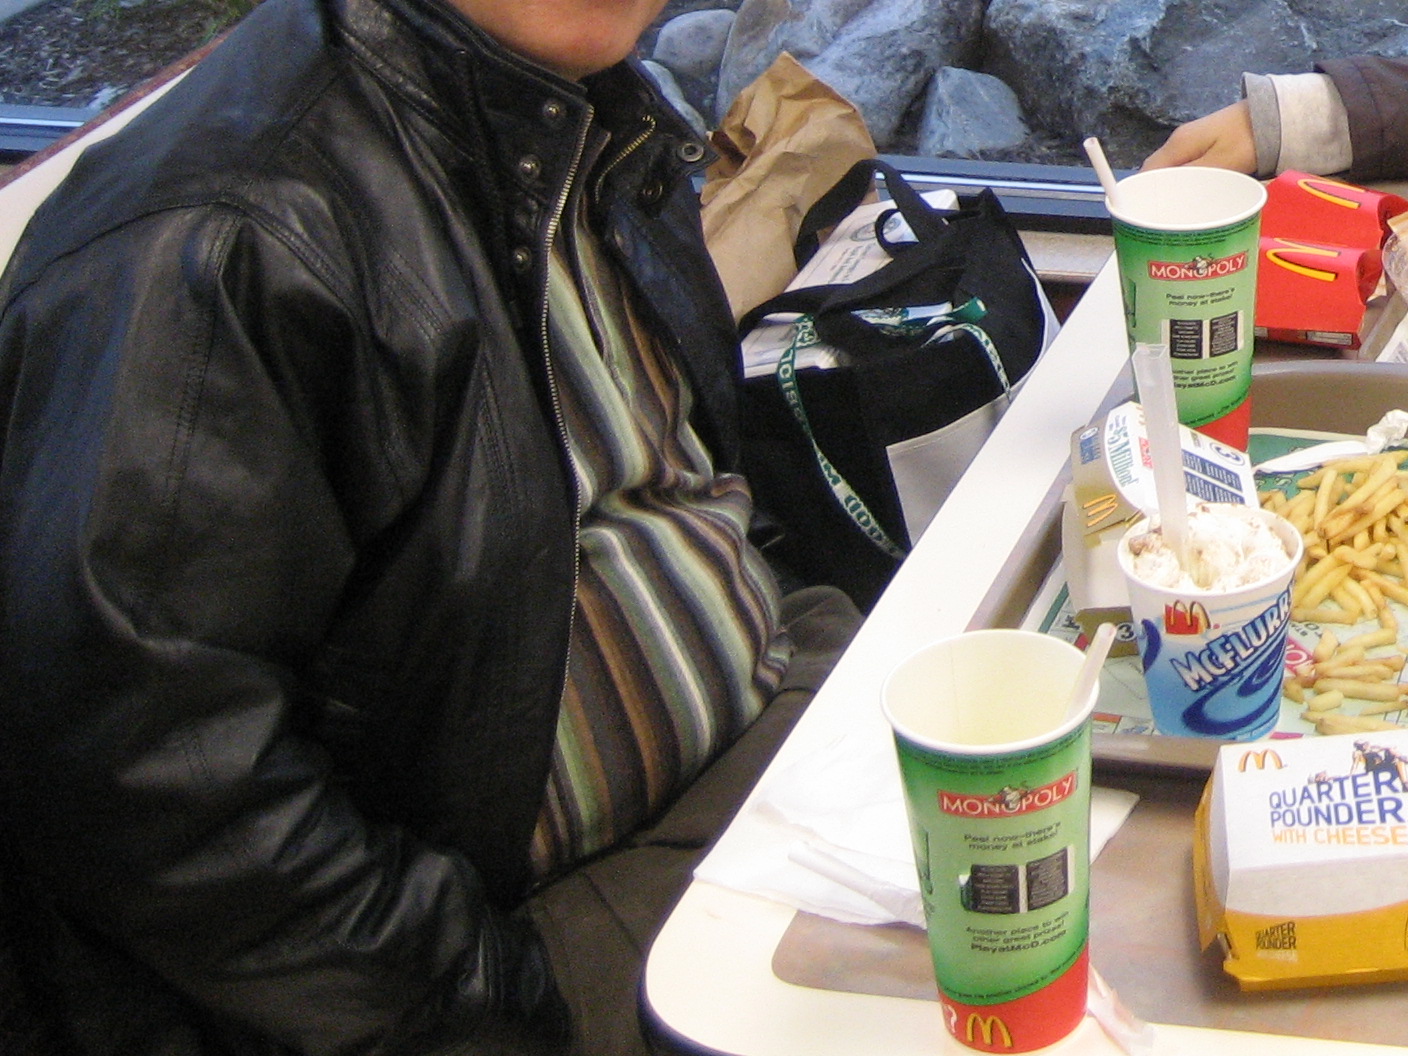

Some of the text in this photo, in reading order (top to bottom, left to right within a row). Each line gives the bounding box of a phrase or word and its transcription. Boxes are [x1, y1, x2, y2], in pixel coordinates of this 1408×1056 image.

[1151, 254, 1244, 280] MONOPOLY
[942, 775, 1074, 816] MONOPOLY
[1269, 770, 1402, 809] QUARTER
[1271, 796, 1406, 828] POUNDER
[1272, 825, 1408, 845] WITH CHEESE
